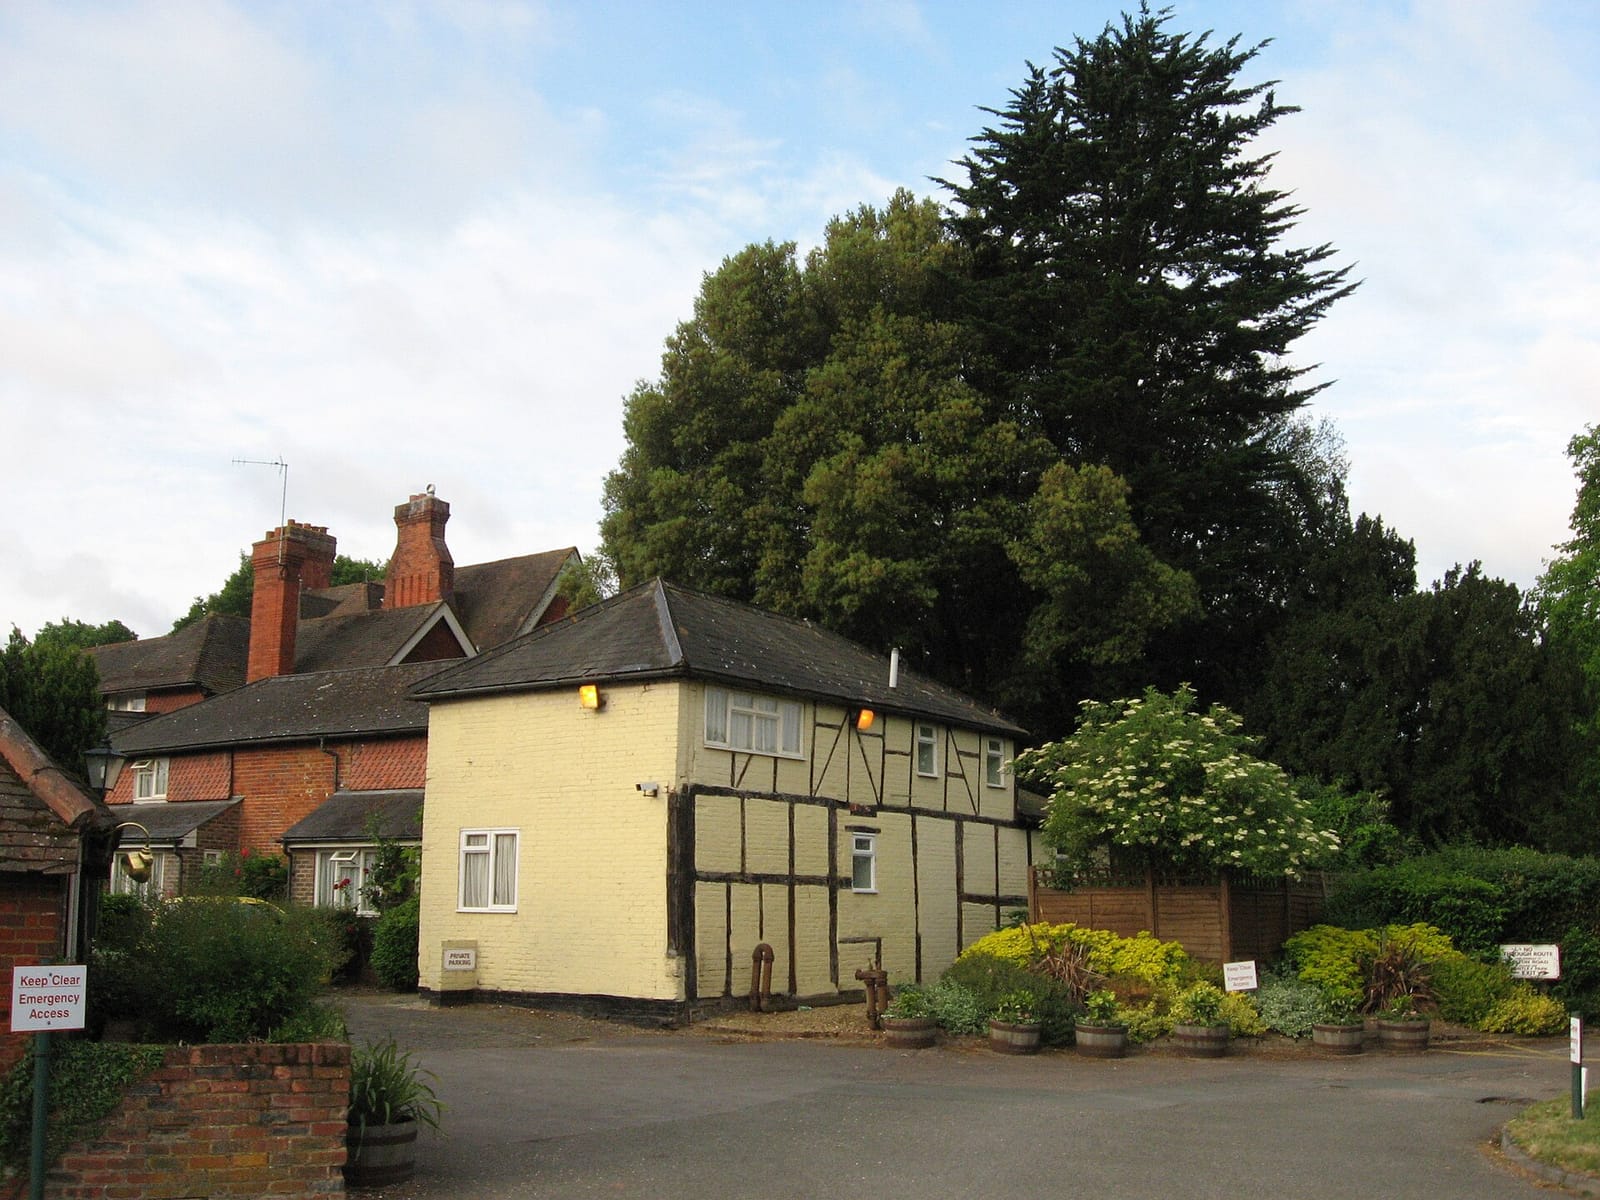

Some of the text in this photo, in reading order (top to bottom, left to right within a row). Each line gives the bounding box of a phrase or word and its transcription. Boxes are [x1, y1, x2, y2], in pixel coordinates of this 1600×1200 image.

[20, 974, 81, 987] Keep Clear
[19, 993, 80, 1006] Emergency
[29, 1008, 70, 1020] Access
